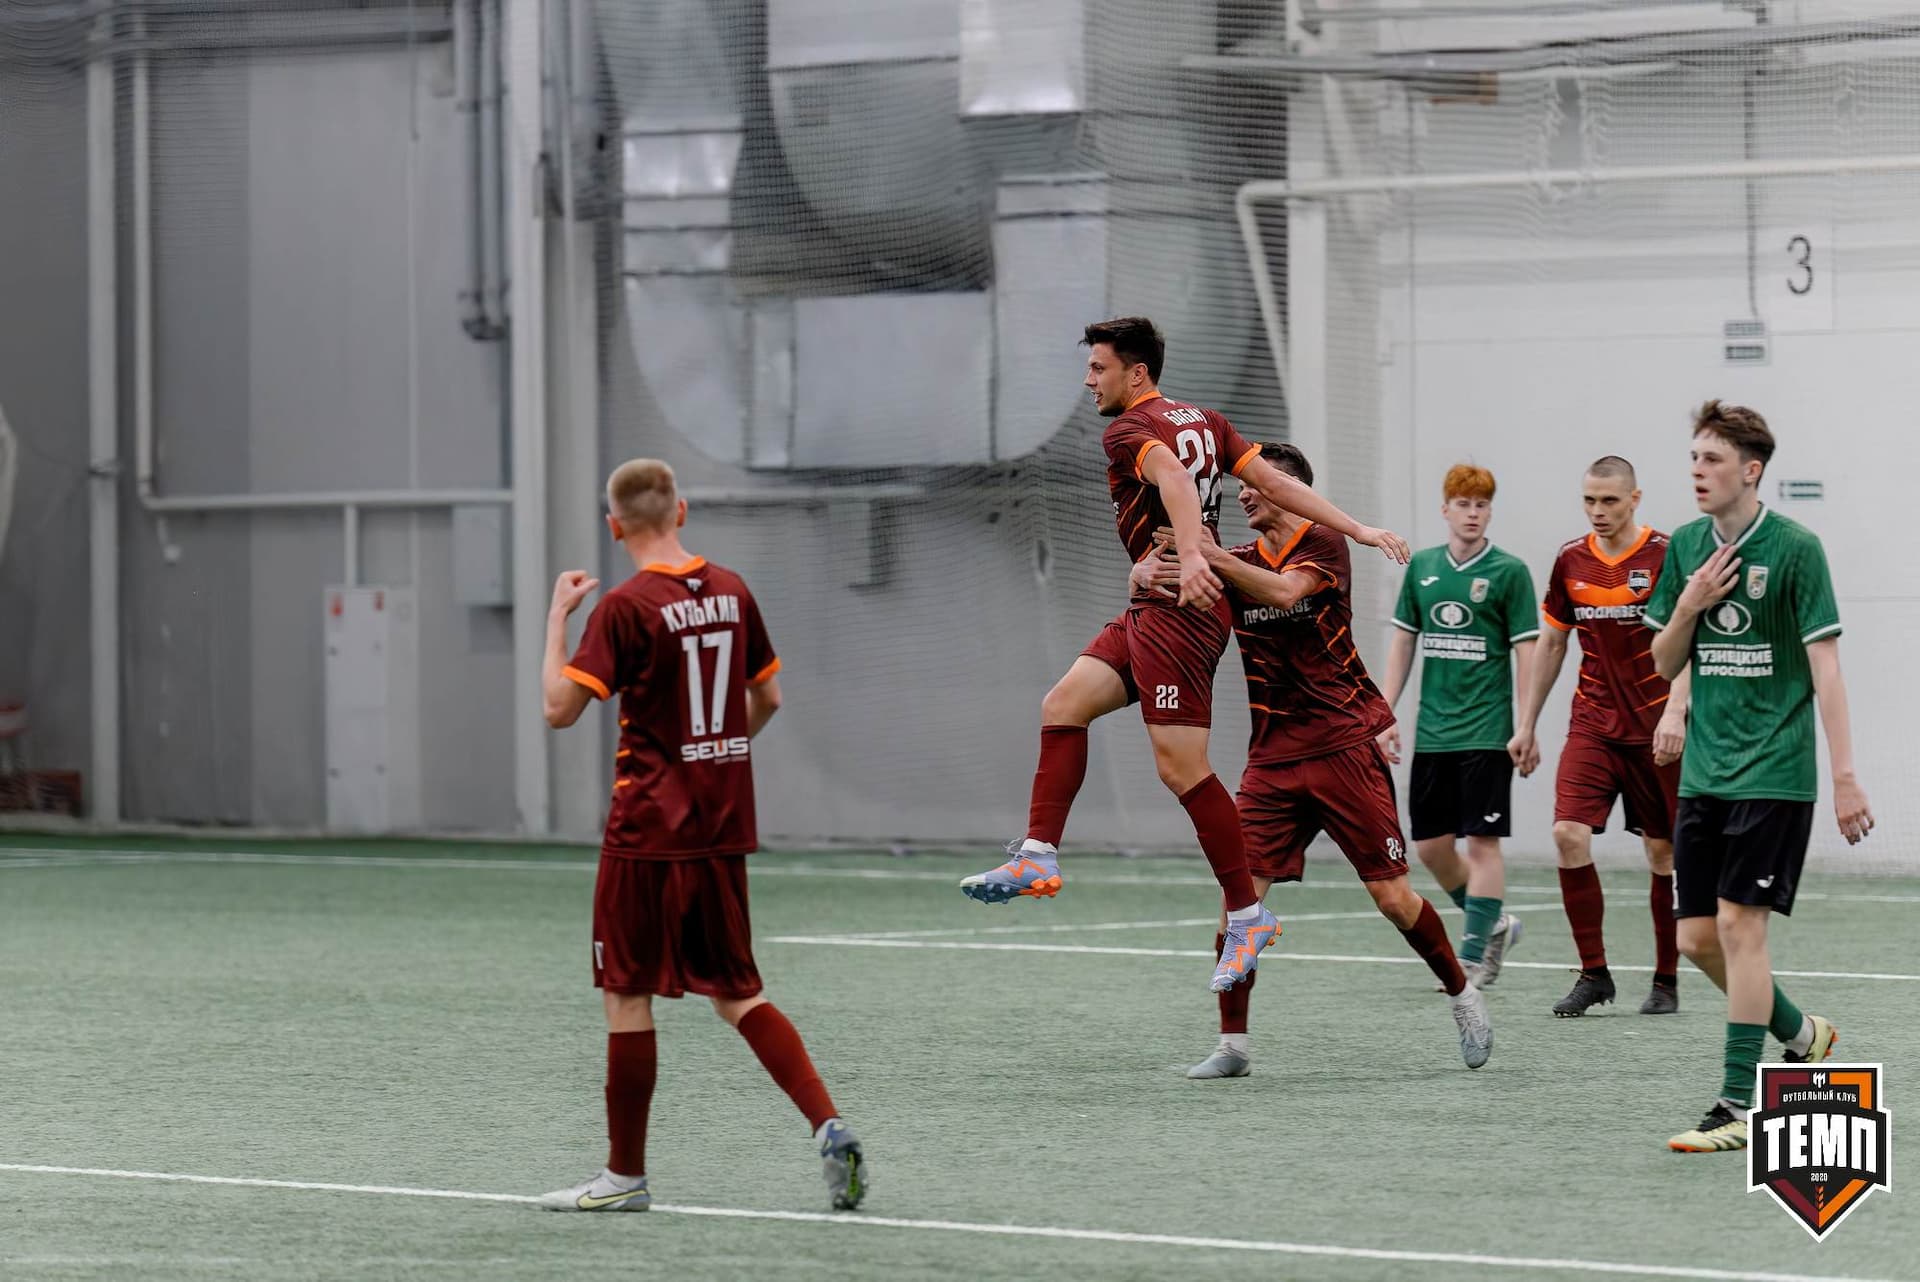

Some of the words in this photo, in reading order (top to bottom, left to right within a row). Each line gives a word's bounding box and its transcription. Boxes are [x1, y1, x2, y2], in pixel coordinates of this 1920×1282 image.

[1786, 236, 1812, 295] 3
[660, 594, 740, 633] КУЗЬКИН
[1697, 650, 1773, 666] УЗНЕЦКИЕ
[681, 630, 733, 737] 17
[1155, 684, 1179, 709] 22
[681, 737, 749, 762] SEUS
[1386, 837, 1403, 860] 24
